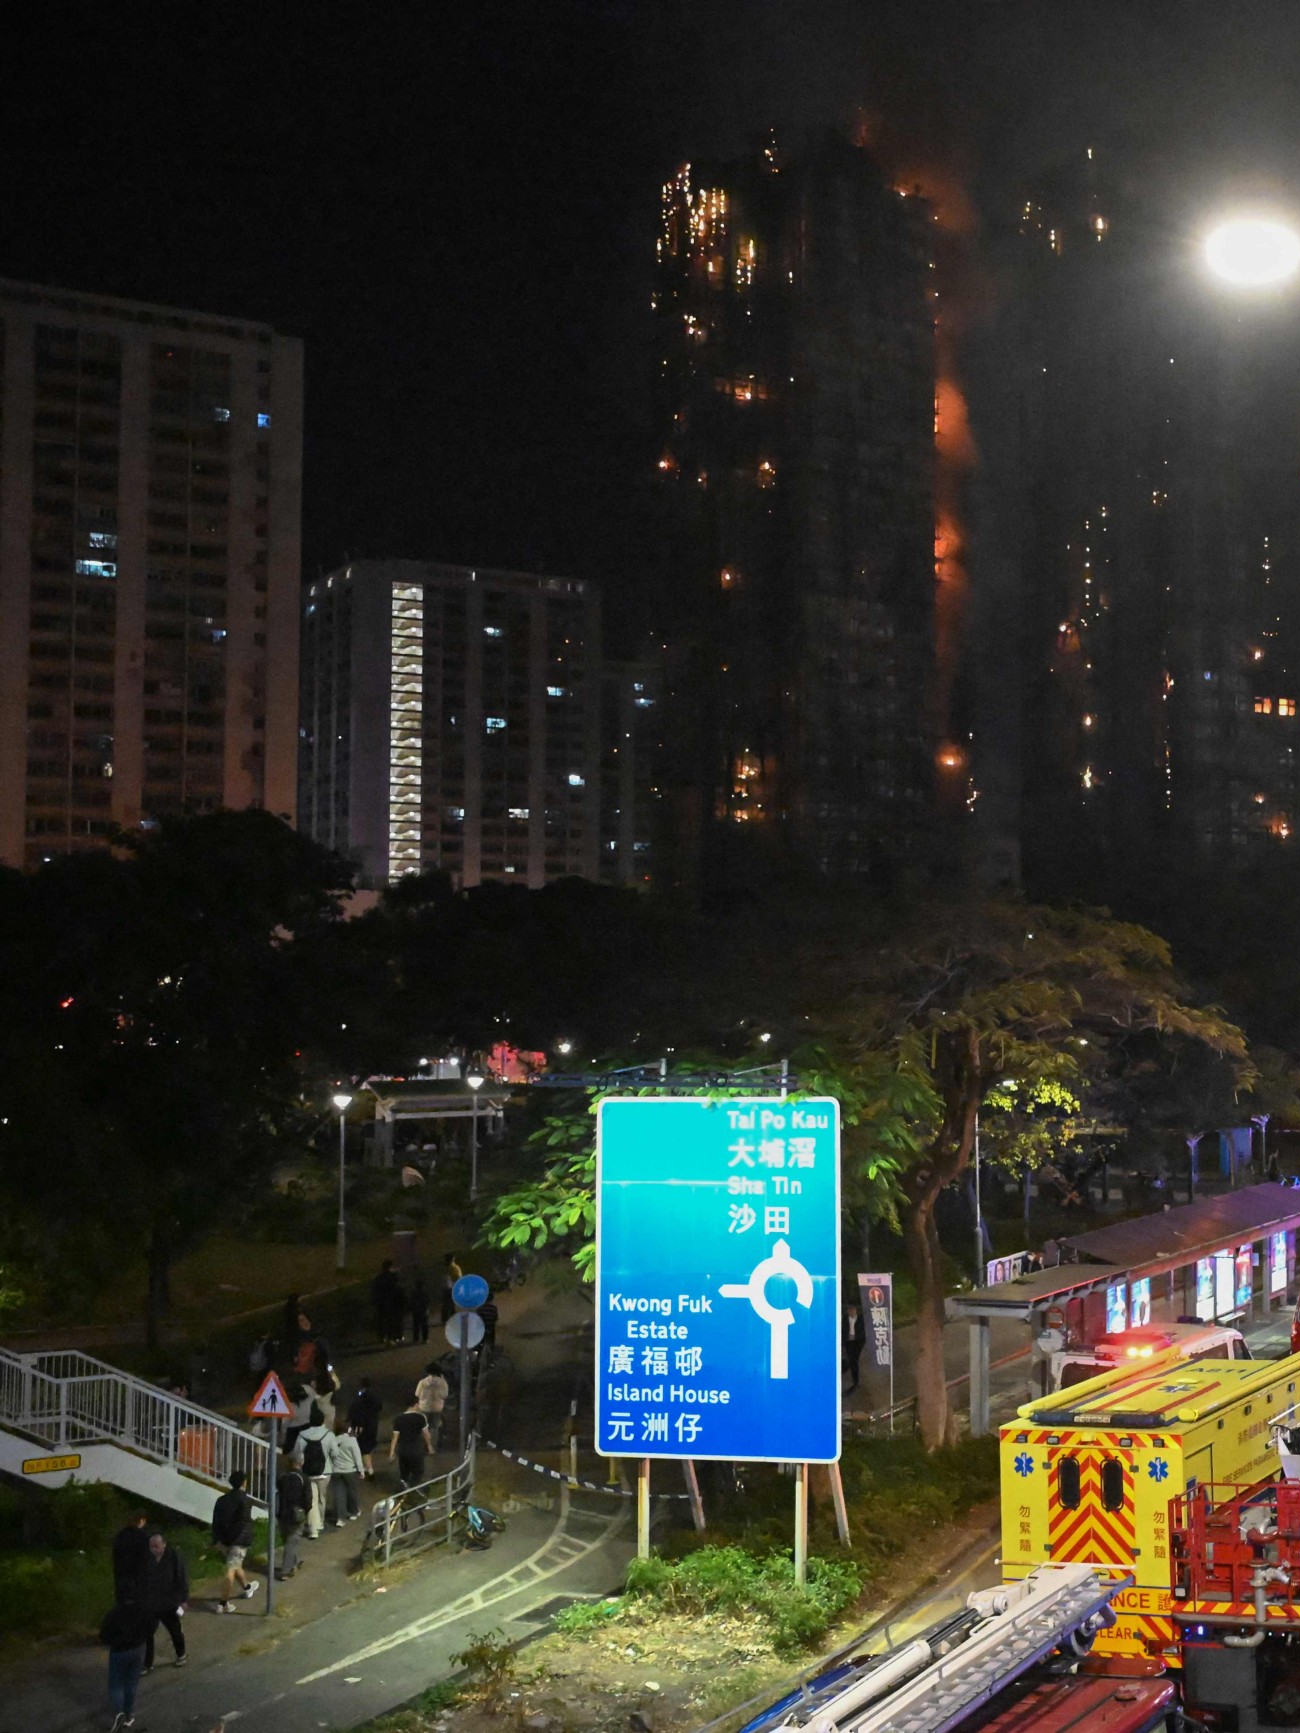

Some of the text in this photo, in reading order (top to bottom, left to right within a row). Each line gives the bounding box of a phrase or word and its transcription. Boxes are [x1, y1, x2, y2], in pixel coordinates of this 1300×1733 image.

[727, 1109, 829, 1130] Tai Po Kau
[728, 1137, 816, 1168] 大埔滘
[727, 1175, 802, 1195] Sha Tin
[728, 1203, 790, 1235] 沙田
[609, 1293, 713, 1316] Kwong Fuk
[627, 1320, 688, 1340] Estate
[608, 1345, 703, 1377] 廣福邨
[608, 1383, 730, 1404] Island House
[608, 1412, 703, 1443] 元洲仔
[1019, 1505, 1032, 1553] 勿緊隨
[1152, 1511, 1167, 1560] 勿緊隨
